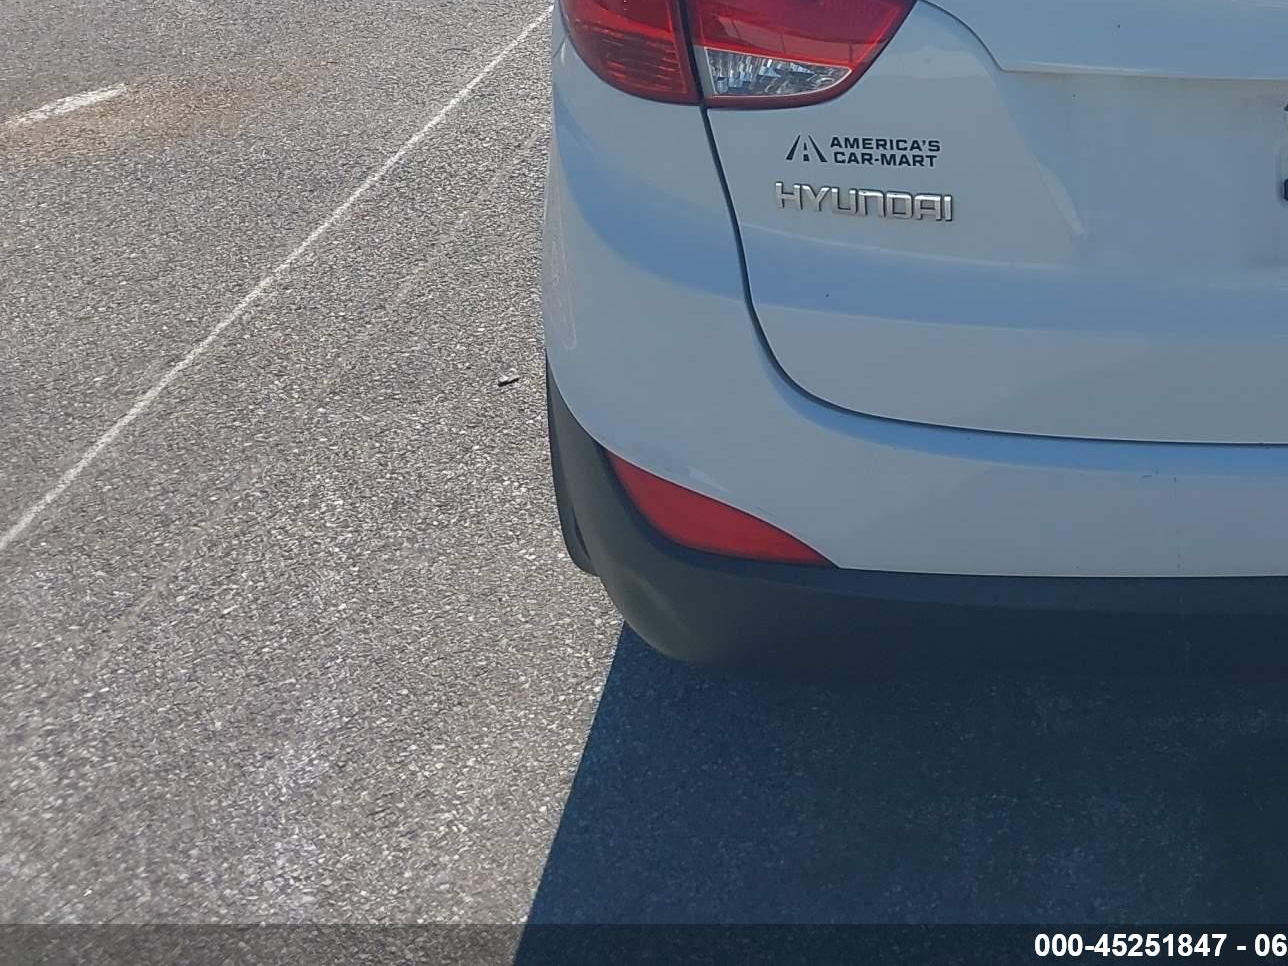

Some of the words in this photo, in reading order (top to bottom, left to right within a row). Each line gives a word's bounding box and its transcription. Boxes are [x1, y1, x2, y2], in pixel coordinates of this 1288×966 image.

[830, 136, 941, 152] AMERICA'S
[834, 151, 937, 167] CAR-MART
[775, 181, 953, 222] HYUNDAI
